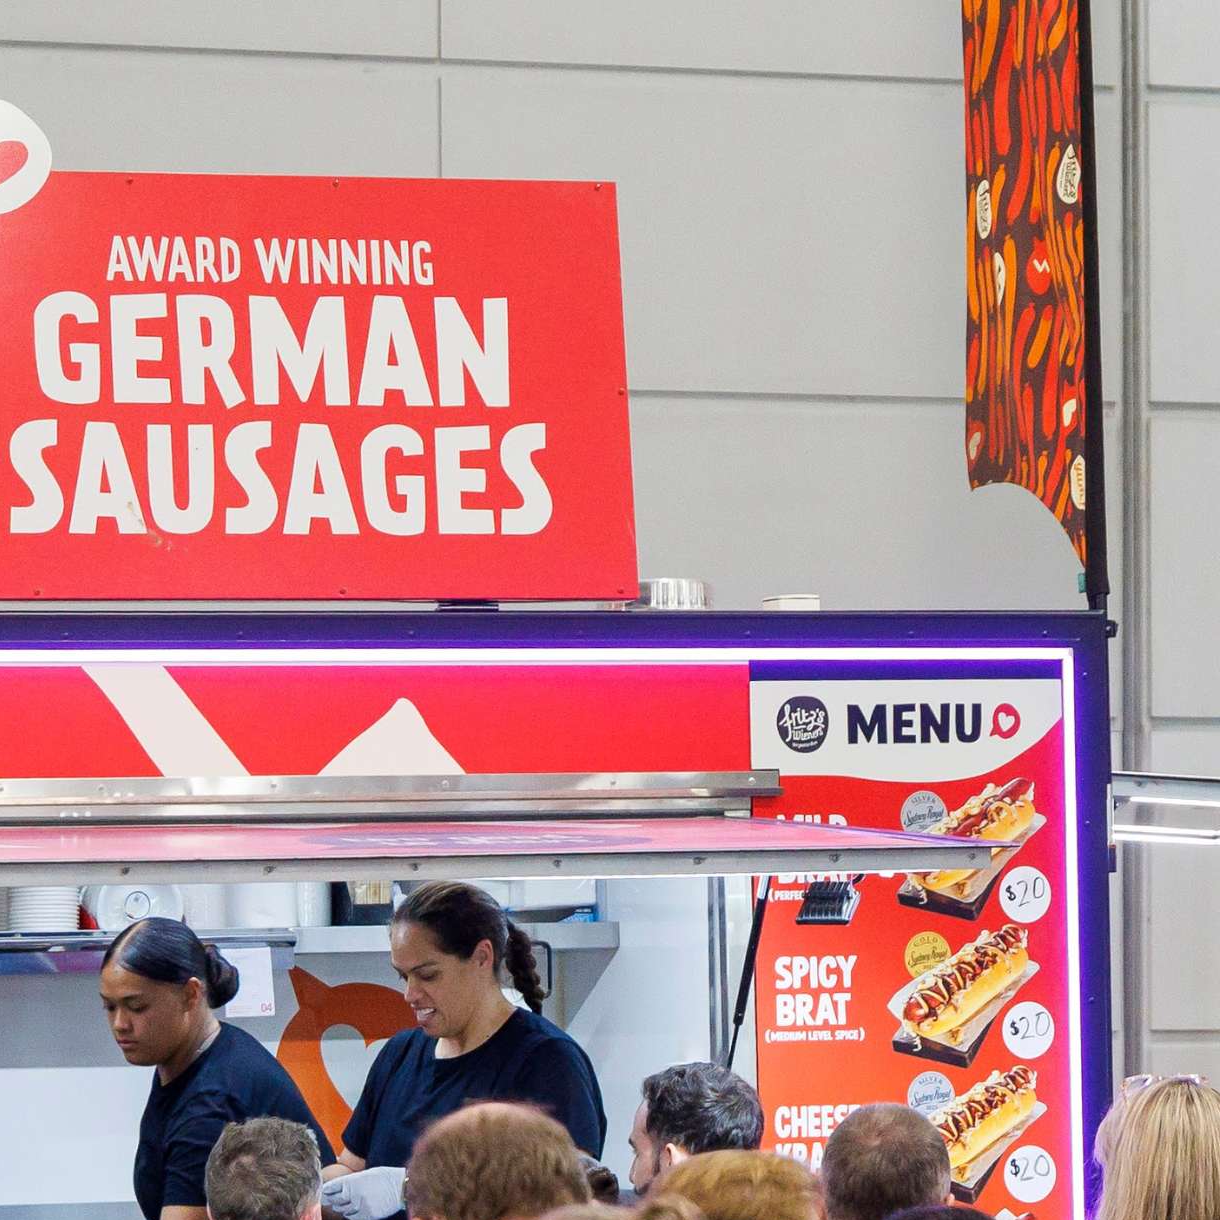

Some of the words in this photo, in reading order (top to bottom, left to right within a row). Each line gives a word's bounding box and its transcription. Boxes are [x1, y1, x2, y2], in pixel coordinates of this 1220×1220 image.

[106, 235, 241, 283] AWARD
[255, 238, 434, 286] WINNING
[33, 291, 510, 409] GERMAN
[9, 419, 553, 536] SAUSAGES
[846, 703, 981, 744] MENU
[1006, 877, 1046, 907] $20
[774, 955, 858, 989] SPICY
[776, 992, 852, 1026] BRAT
[1010, 1011, 1051, 1040] $20
[774, 1104, 861, 1138] CHEES
[1010, 1154, 1051, 1181] $20
